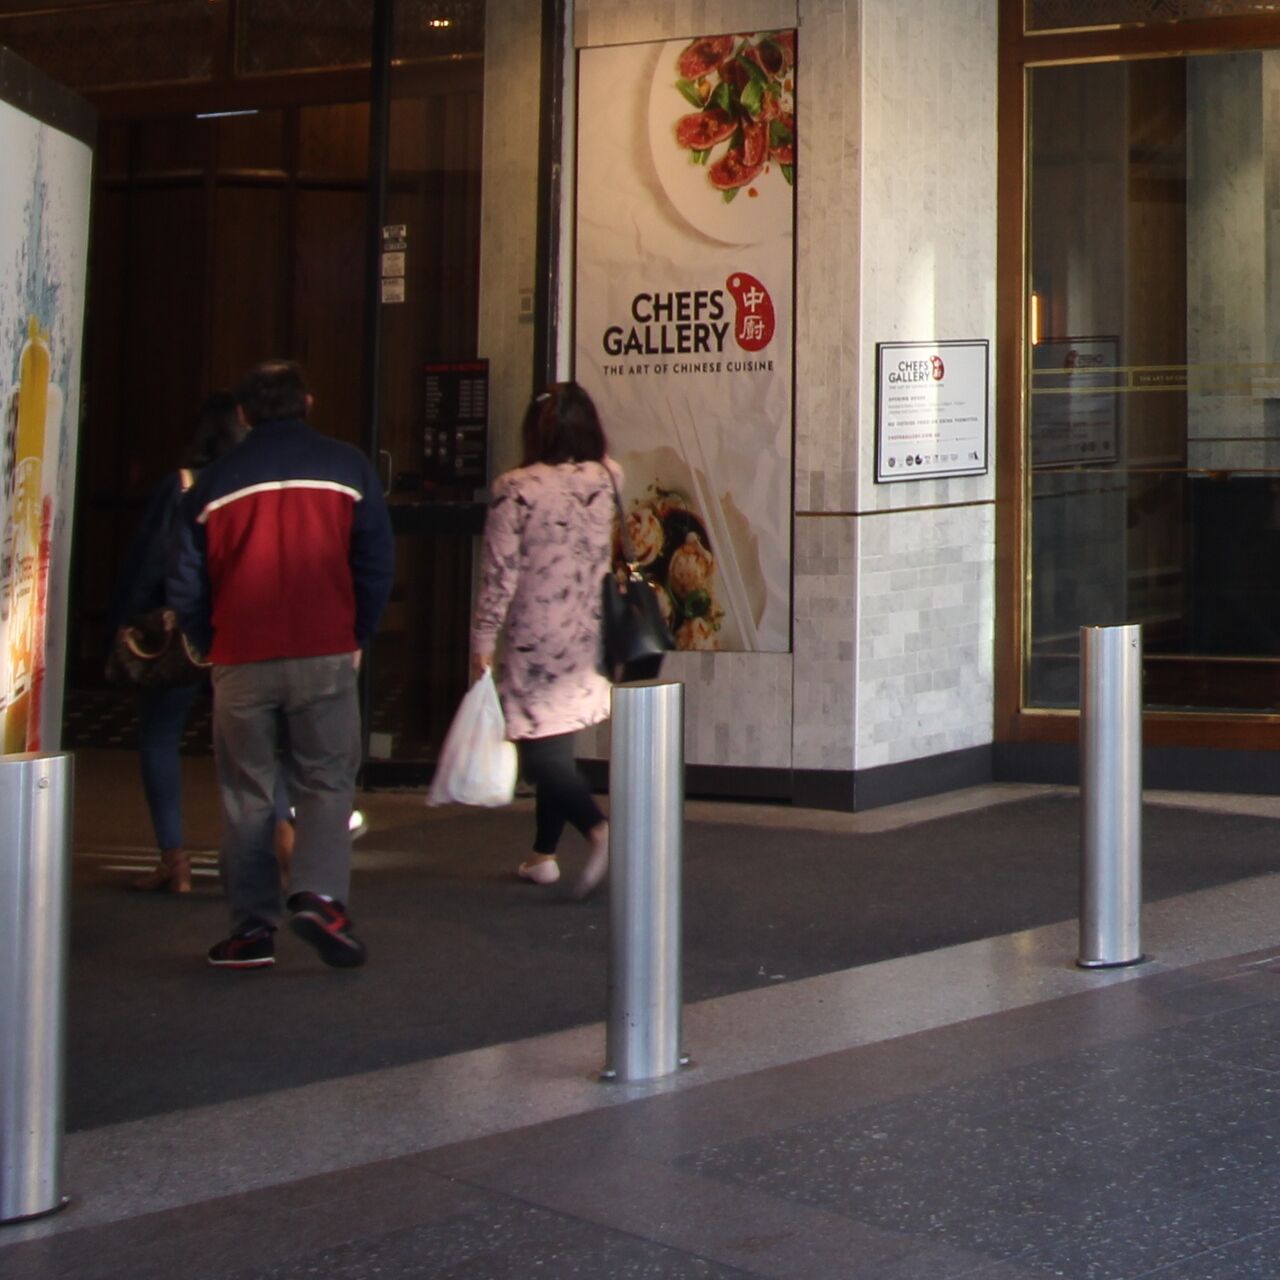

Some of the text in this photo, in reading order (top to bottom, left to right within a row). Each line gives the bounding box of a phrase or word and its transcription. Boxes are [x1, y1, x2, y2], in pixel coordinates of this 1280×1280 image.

[632, 290, 724, 323] CHEFS
[603, 322, 729, 355] GALLERY
[604, 360, 773, 376] THE ART OF CHINESE CUISINE
[898, 360, 928, 372] CHEFS
[888, 371, 930, 383] GALLERY
